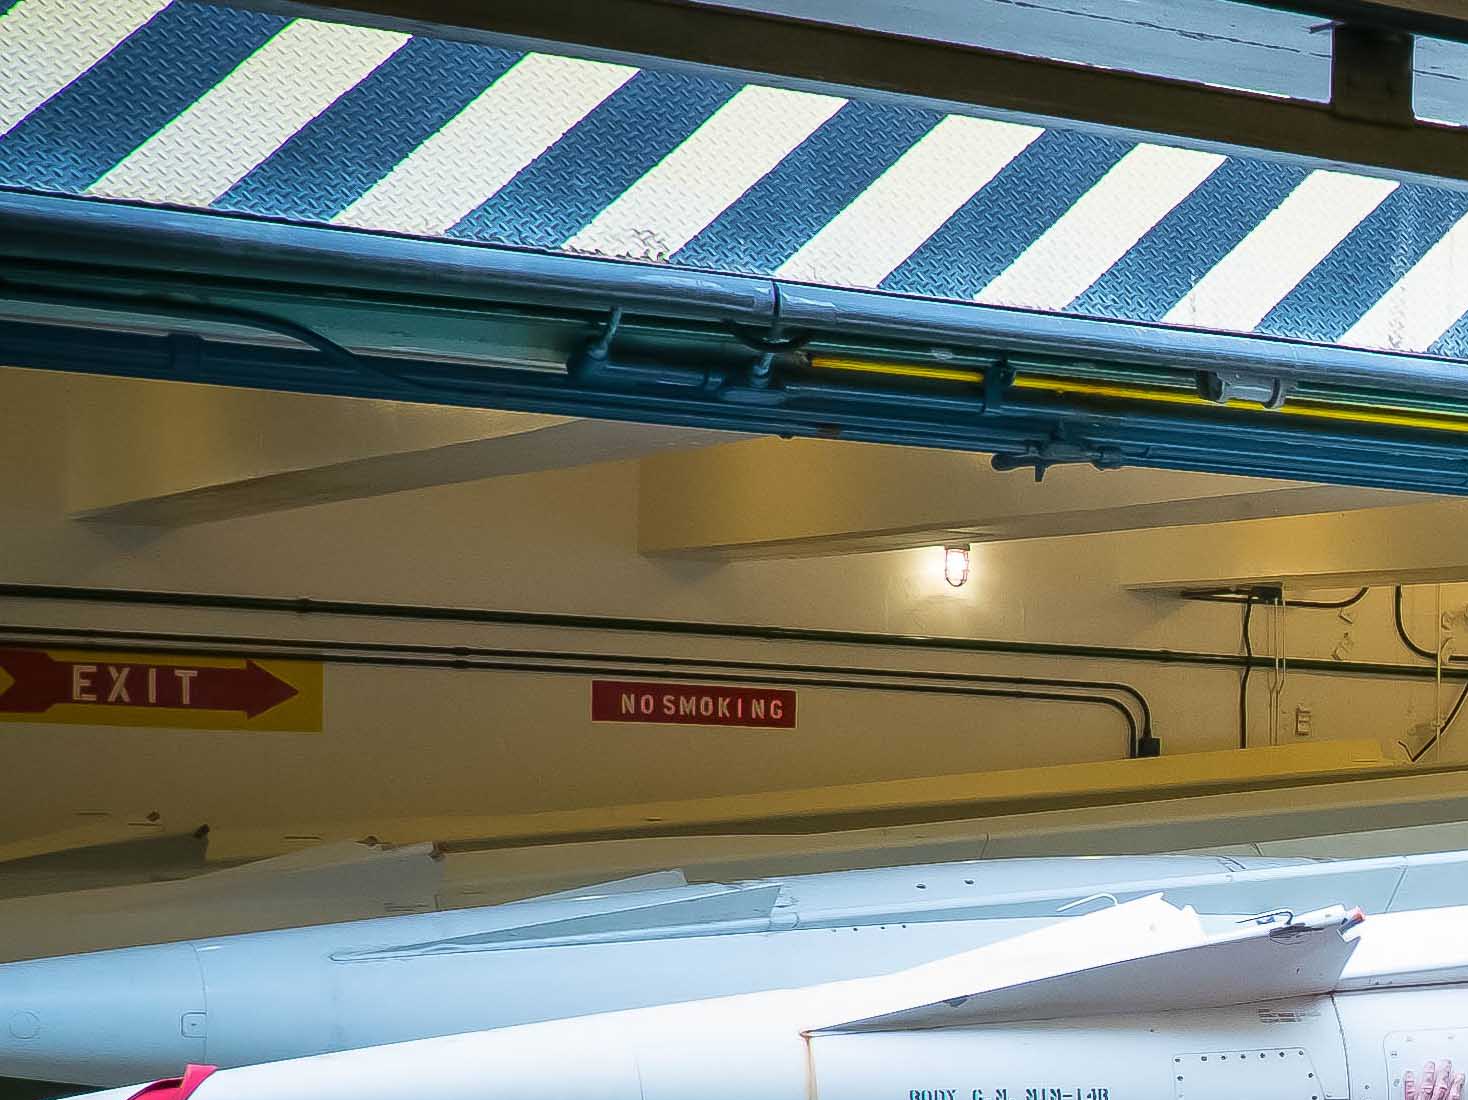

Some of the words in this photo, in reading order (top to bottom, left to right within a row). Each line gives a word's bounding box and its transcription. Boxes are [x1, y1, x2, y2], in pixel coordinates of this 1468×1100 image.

[72, 664, 198, 705] EXIT
[621, 693, 655, 715] NO
[663, 694, 784, 720] SMOKING
